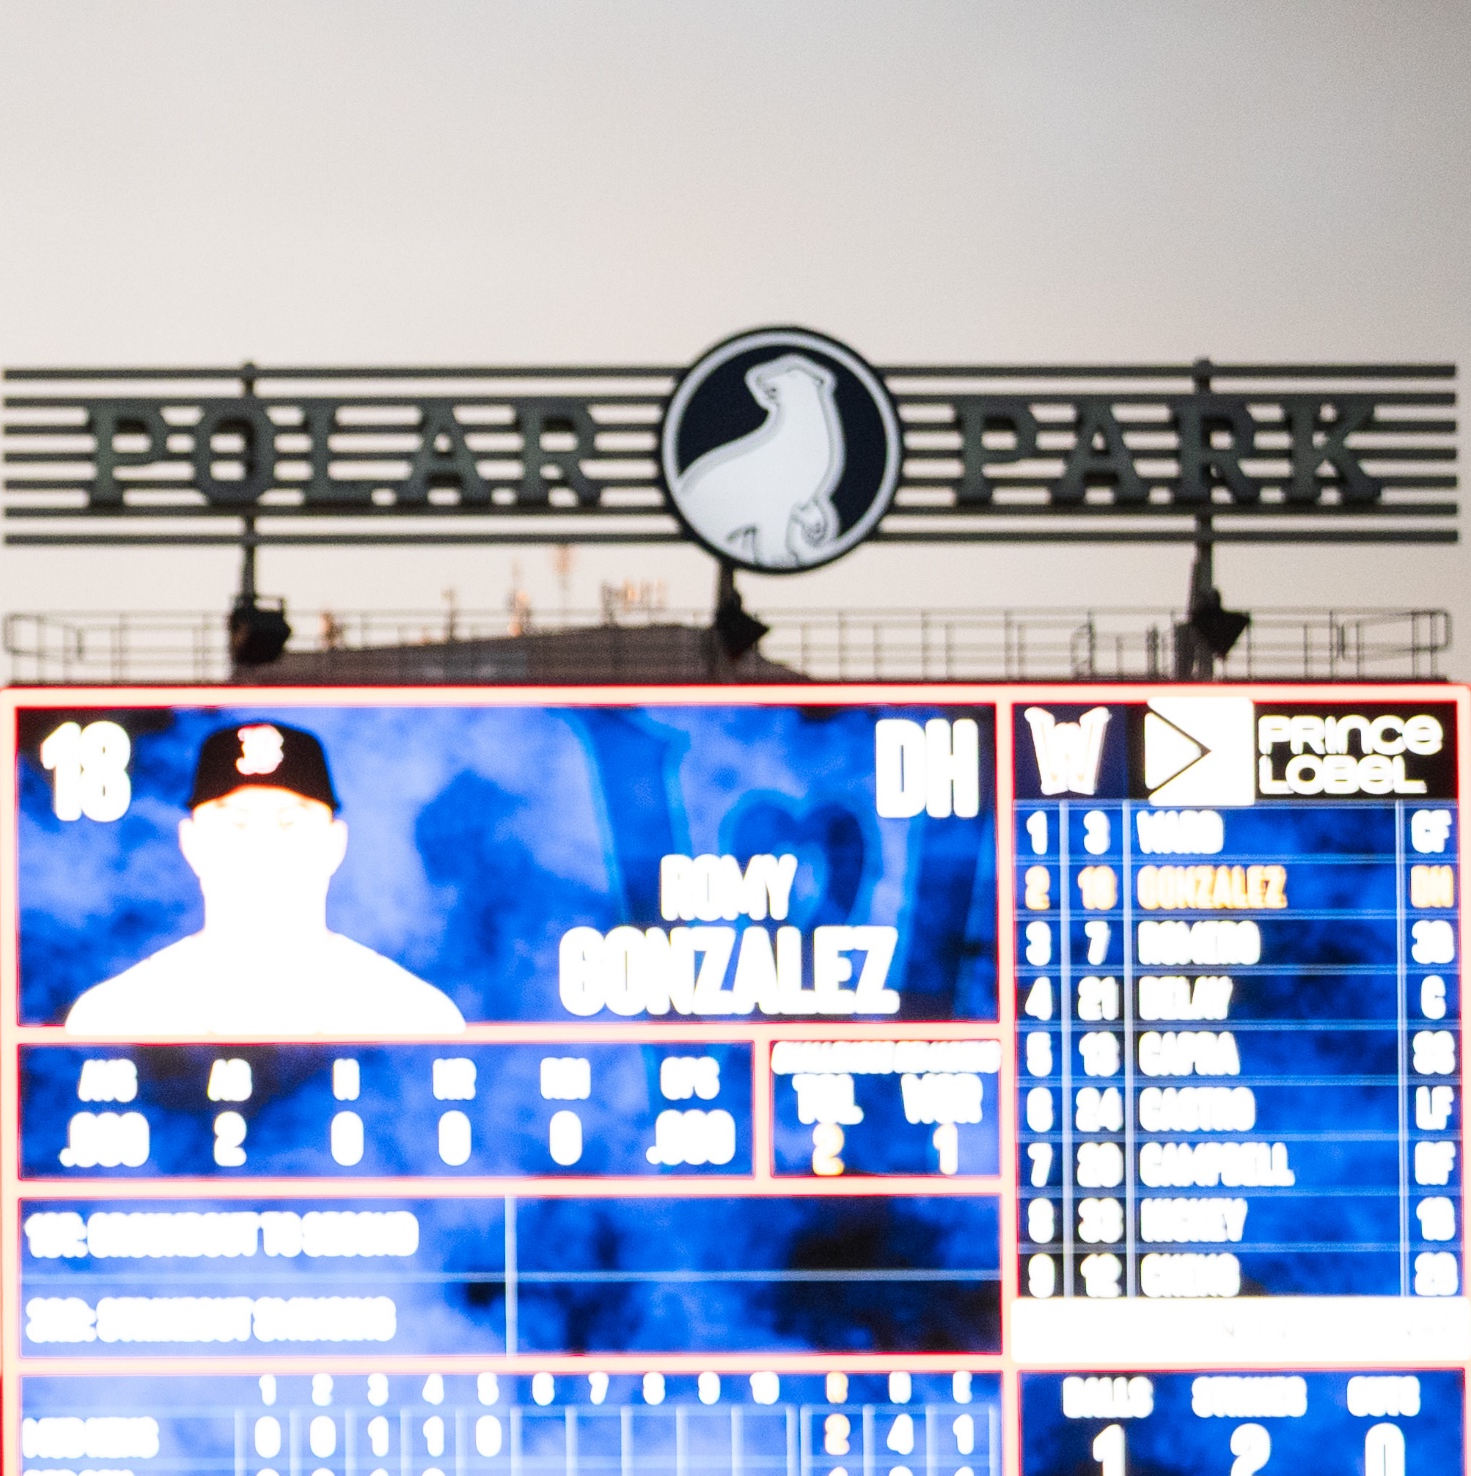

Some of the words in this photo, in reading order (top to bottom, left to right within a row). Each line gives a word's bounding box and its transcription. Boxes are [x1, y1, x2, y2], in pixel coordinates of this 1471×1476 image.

[87, 397, 602, 509] POLAR
[956, 397, 1383, 507] PARK
[41, 720, 131, 822] 18
[875, 718, 979, 818] DH
[660, 853, 798, 921] ROMY
[1025, 865, 1050, 910] 2
[1137, 865, 1287, 910] GONZALEZ
[559, 925, 900, 1016] GONZALEZ
[214, 1111, 247, 1167] 2
[812, 1124, 845, 1176] 2
[933, 1124, 959, 1175] 1
[259, 1371, 277, 1406] 1
